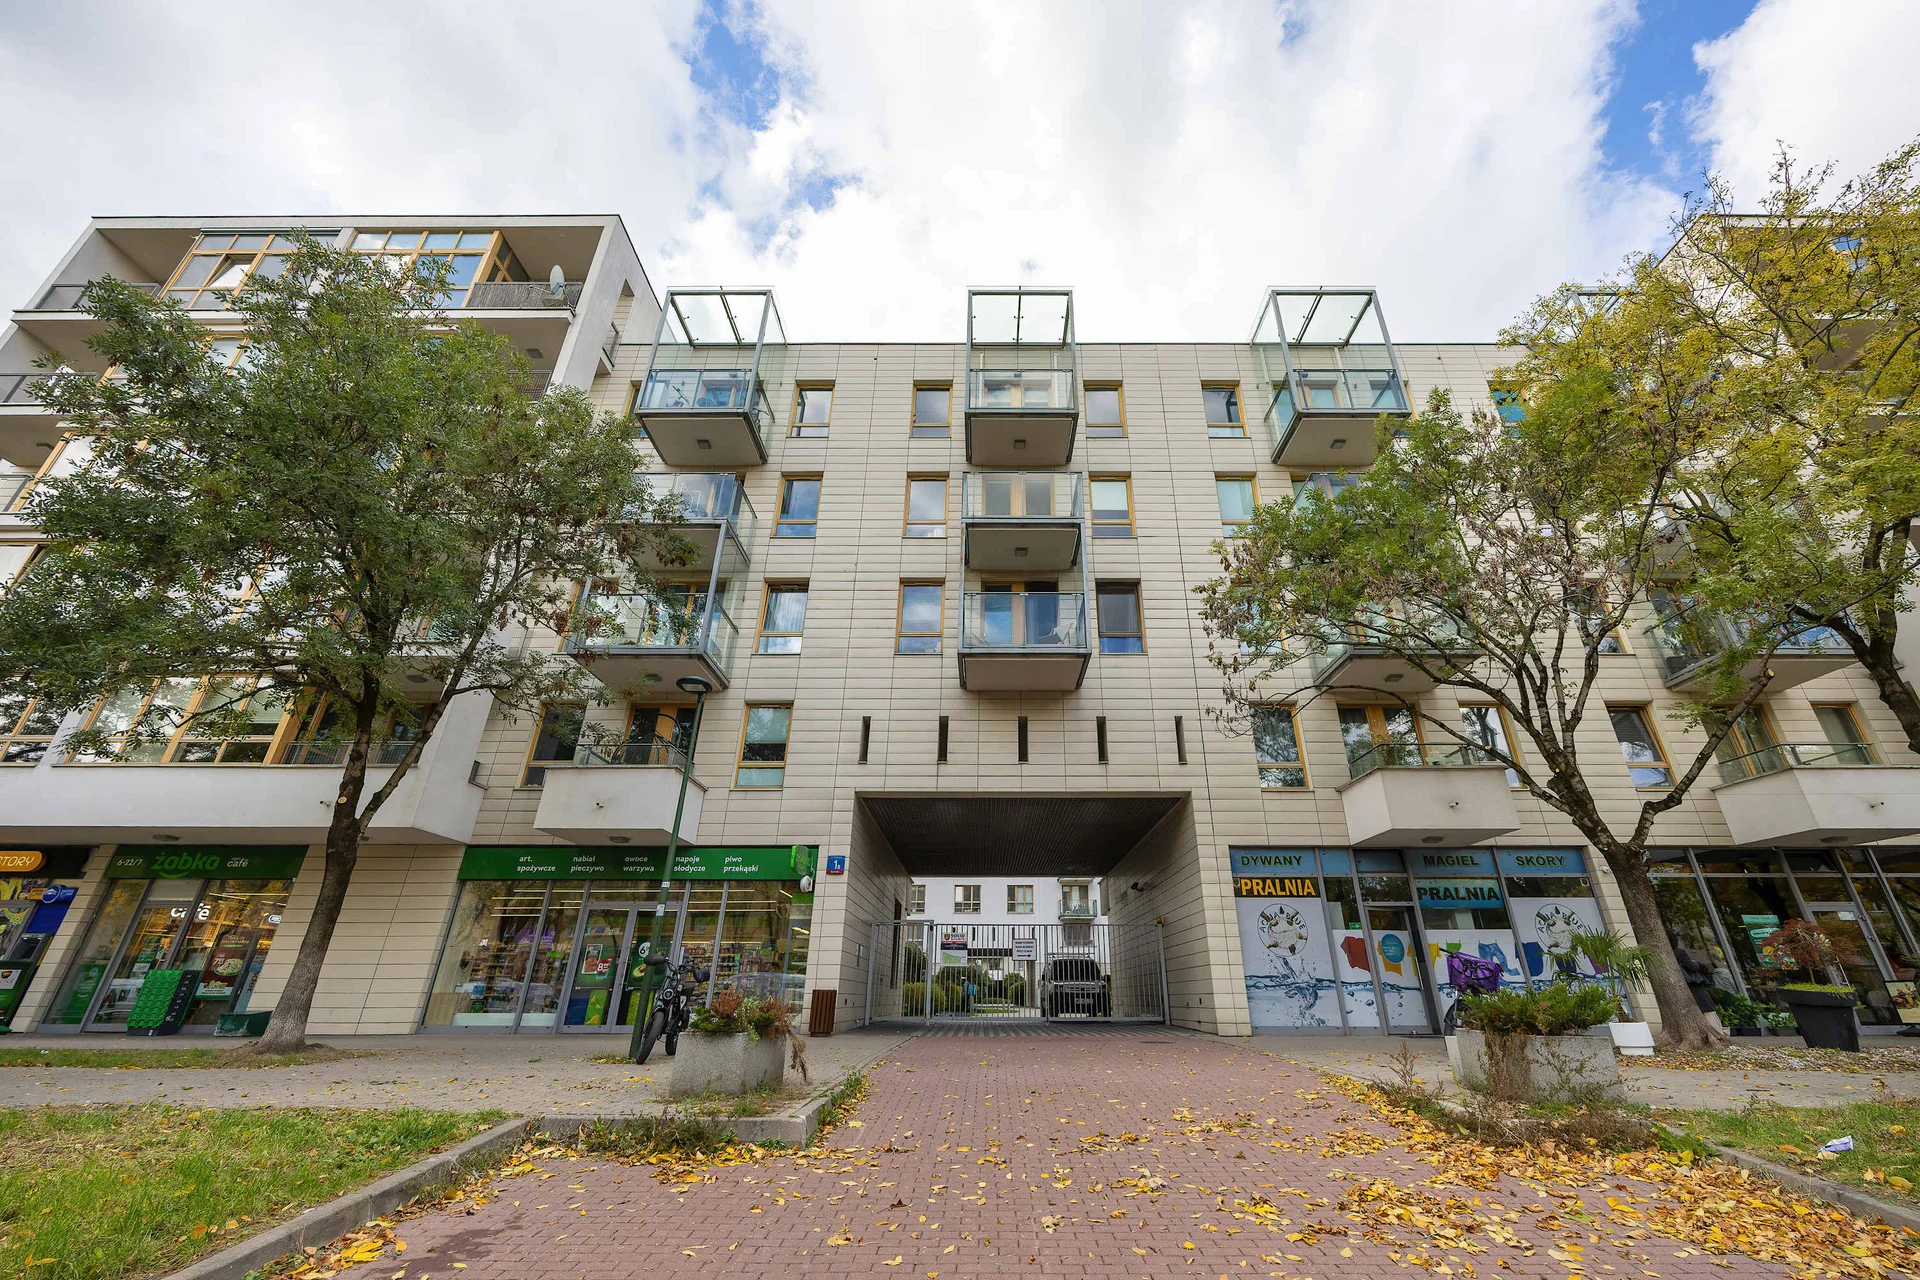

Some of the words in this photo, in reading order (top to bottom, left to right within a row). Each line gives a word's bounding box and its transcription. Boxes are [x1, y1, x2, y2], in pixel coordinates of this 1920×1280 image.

[150, 852, 220, 870] żabka
[675, 856, 700, 864] napoje
[724, 856, 742, 864] piwo
[1241, 856, 1302, 866] DYWANY
[1422, 856, 1480, 866] MAGIEL
[1516, 854, 1564, 866] SKÓRY
[516, 864, 556, 873] spożywcze
[570, 864, 604, 873] pieczywo
[673, 864, 706, 873] słodycze
[723, 864, 759, 873] przekąski
[1240, 878, 1316, 896] PRALNIA
[1416, 887, 1500, 900] PRALNIA
